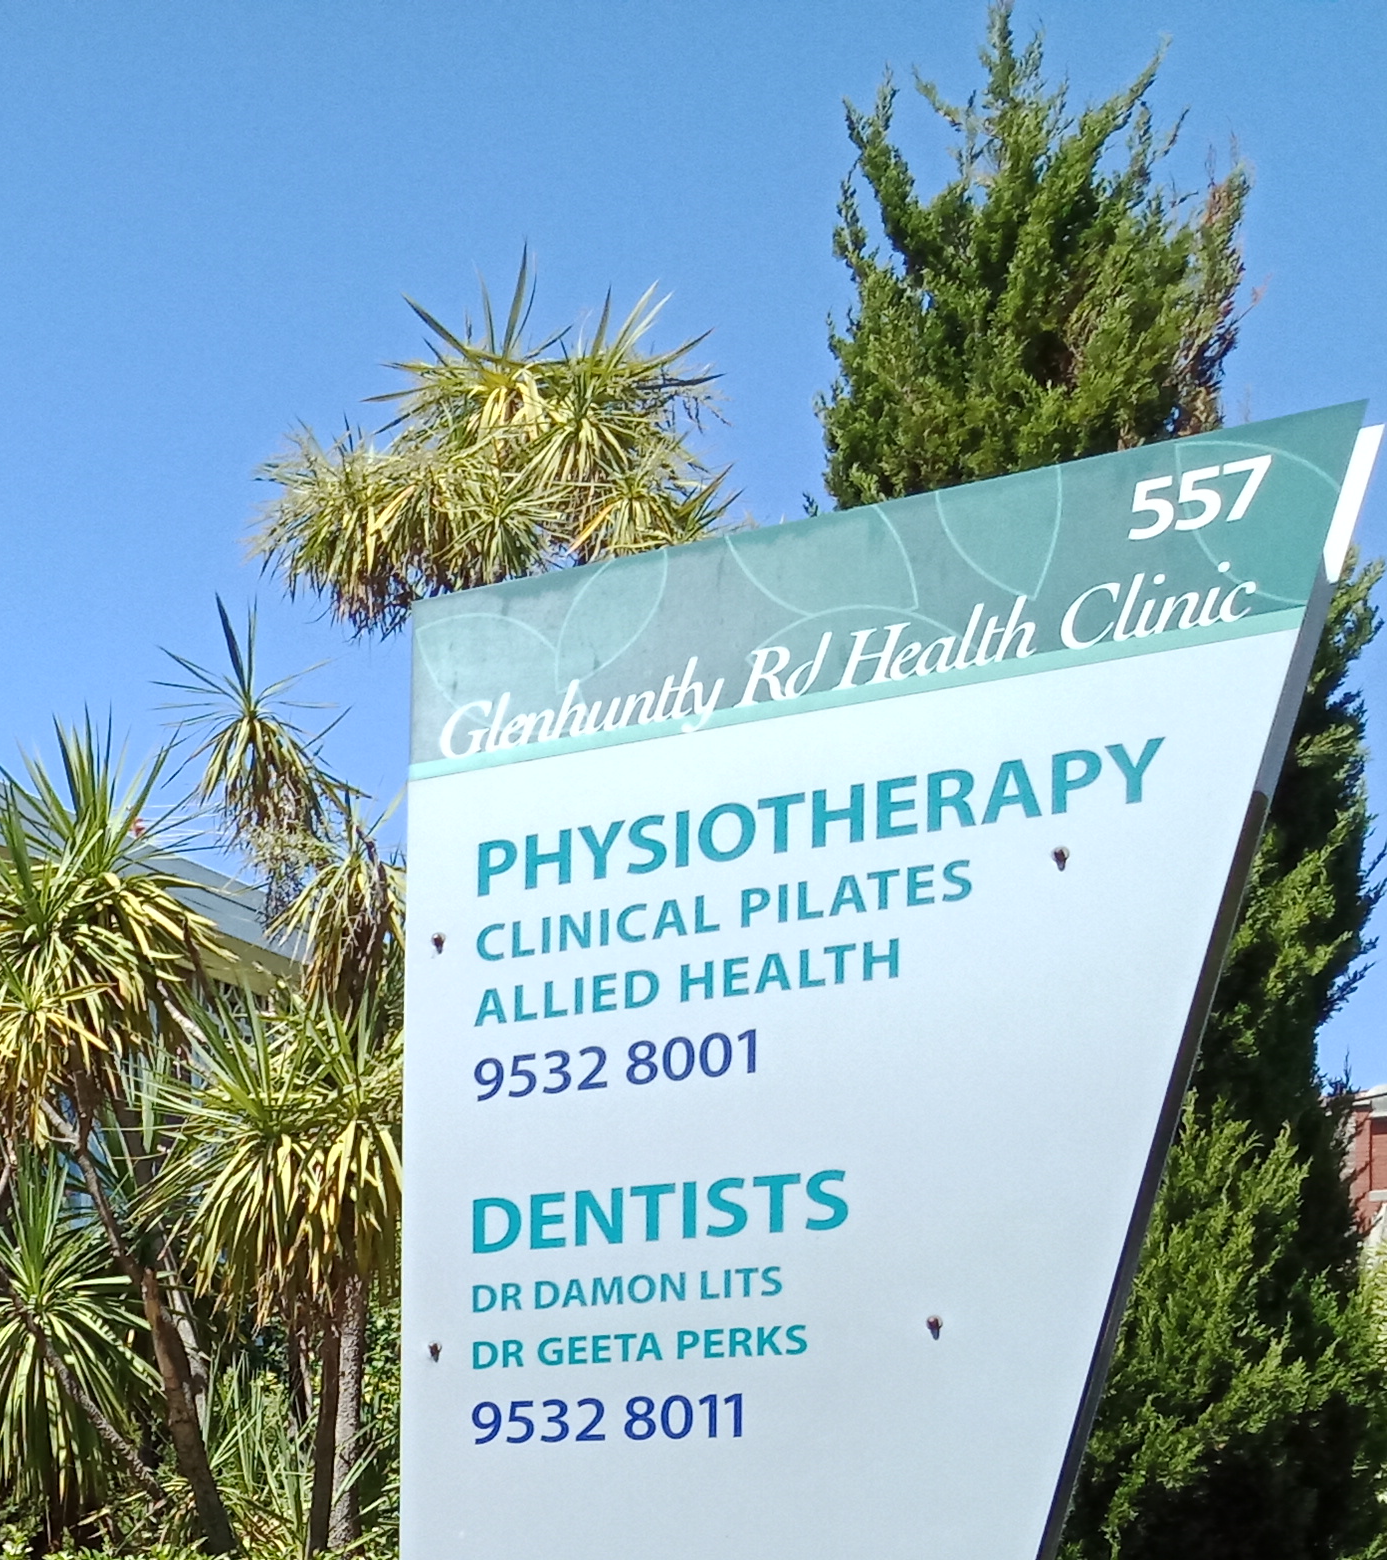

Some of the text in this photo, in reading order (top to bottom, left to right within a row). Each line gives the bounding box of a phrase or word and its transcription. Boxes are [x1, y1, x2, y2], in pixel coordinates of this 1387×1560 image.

[1129, 455, 1271, 539] 557
[438, 561, 1257, 760] Glenhuntly Rd Health Clinic
[478, 737, 1165, 897] PHYSIOTHERAPY
[476, 860, 972, 961] CLINICAL PILATES
[474, 938, 899, 1027] ALLIED HEALTH
[474, 1029, 757, 1101] 9532 8001
[472, 1169, 849, 1254] DENTISTS
[473, 1266, 783, 1313] DR DAMON LITS
[472, 1325, 808, 1370] DR GEETA PERKS
[472, 1393, 743, 1445] 9532 8011
